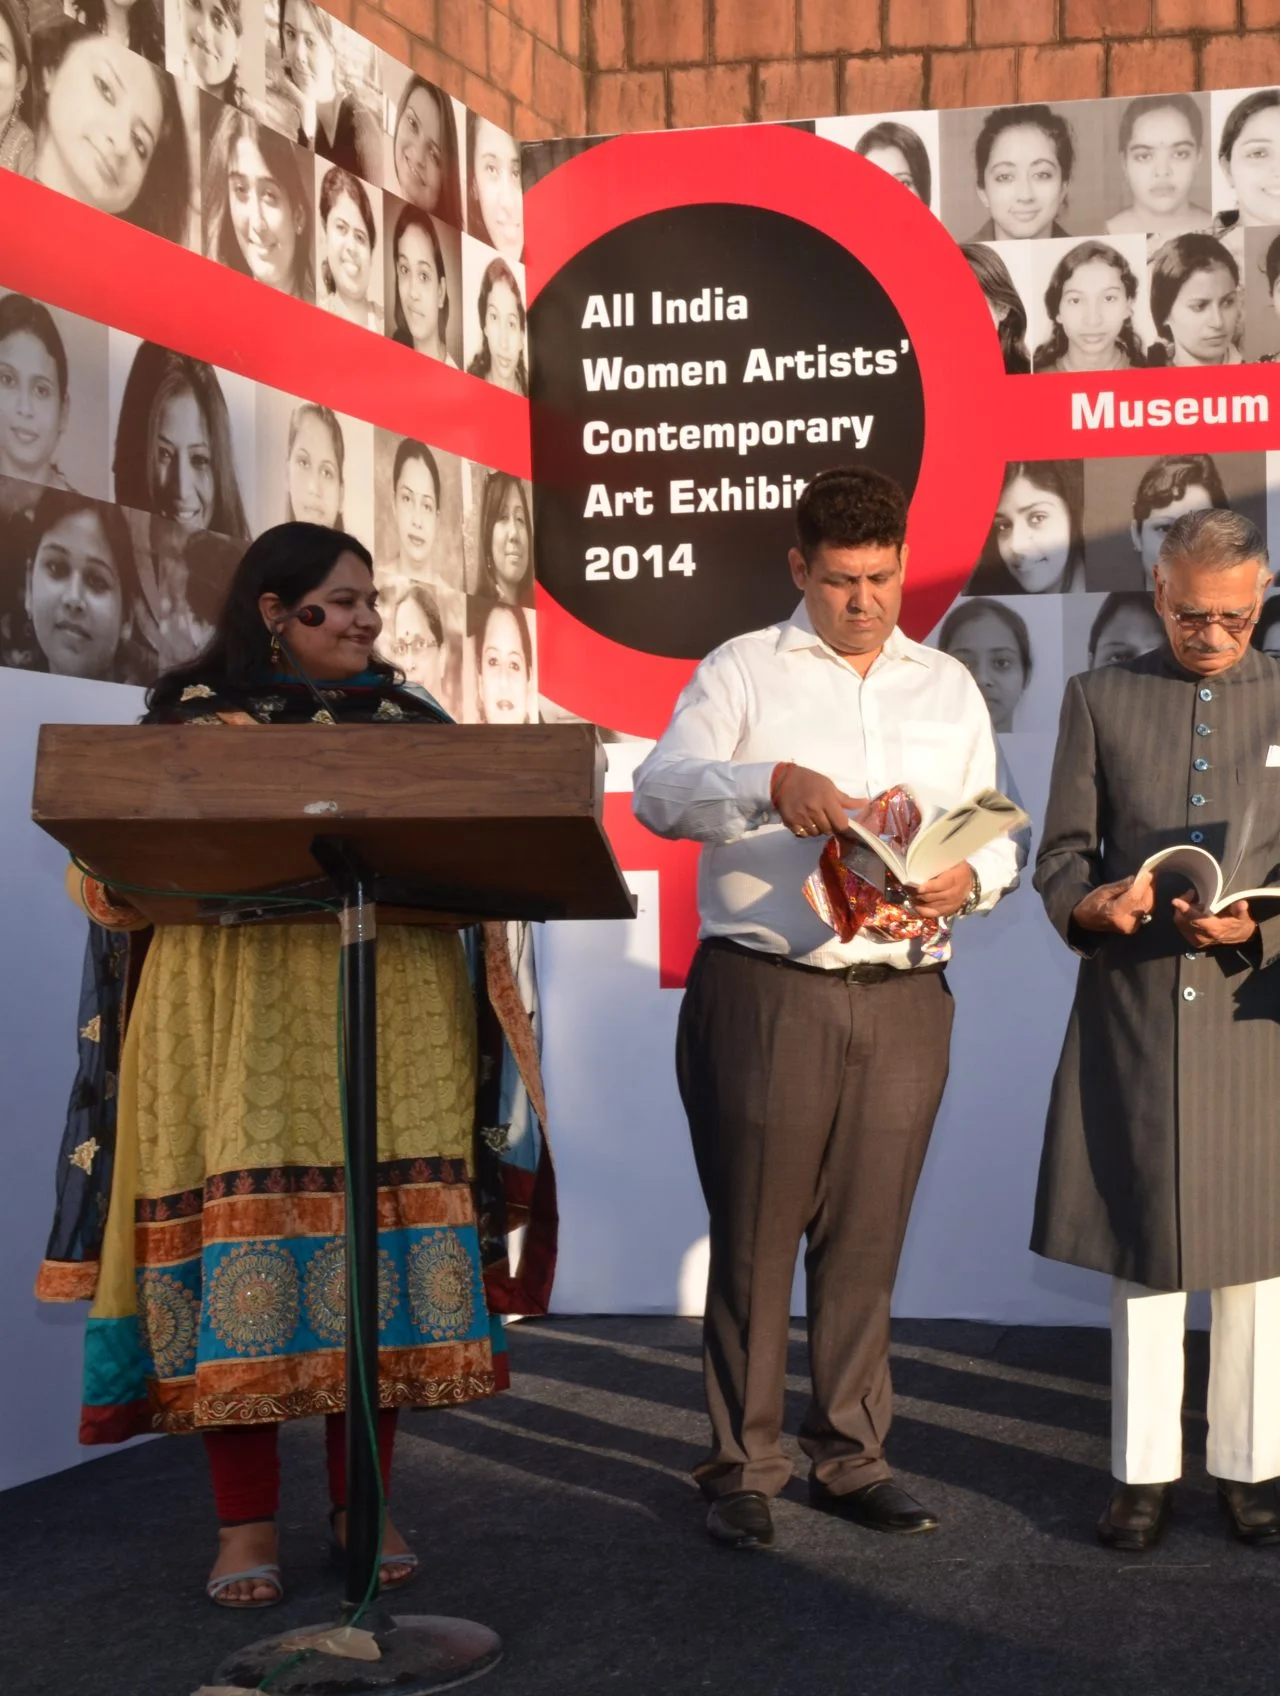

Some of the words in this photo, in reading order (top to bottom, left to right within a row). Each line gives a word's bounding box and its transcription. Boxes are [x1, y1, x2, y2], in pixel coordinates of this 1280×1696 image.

[581, 292, 634, 329] All
[651, 287, 748, 325] India
[582, 356, 727, 392] Women
[742, 339, 909, 383] Artists'
[1071, 391, 1269, 430] Museum
[583, 415, 874, 456] Contemporary
[583, 483, 654, 518] Art
[669, 474, 812, 514] Exhibit
[585, 543, 697, 581] 2014
